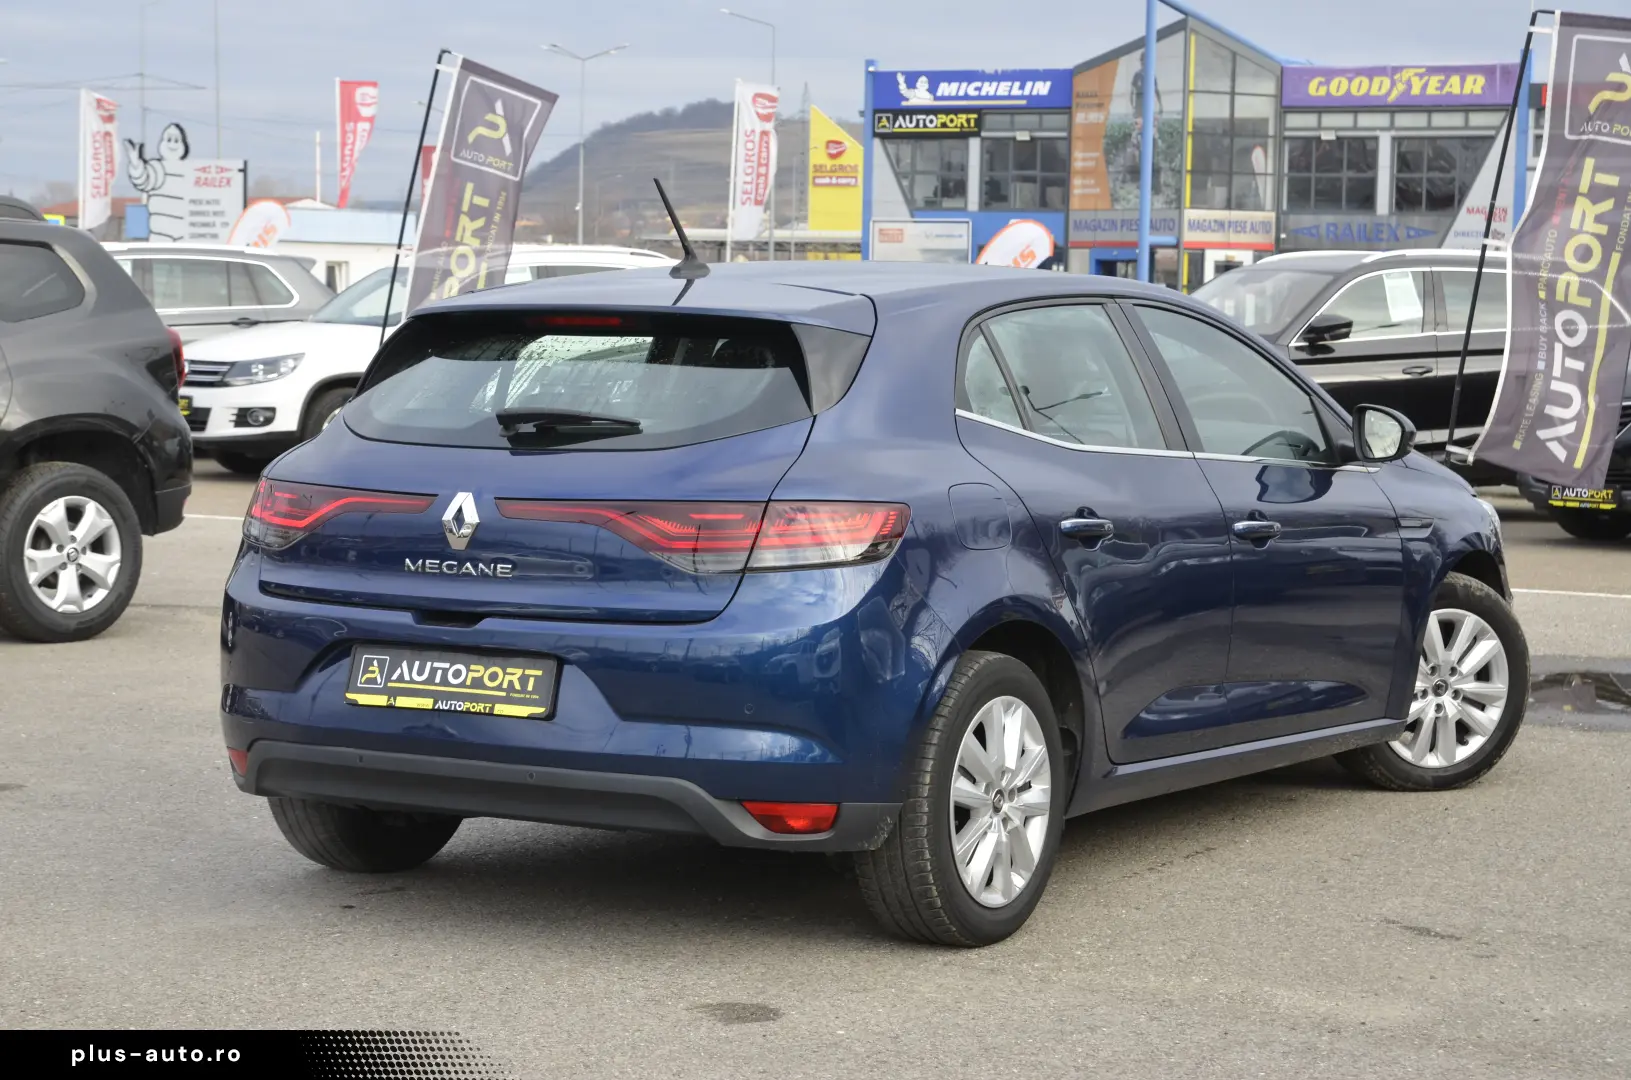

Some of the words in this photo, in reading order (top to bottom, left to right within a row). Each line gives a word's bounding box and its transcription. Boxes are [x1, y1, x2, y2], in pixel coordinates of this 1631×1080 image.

[936, 81, 1051, 96] MICHELIN
[1308, 74, 1486, 97] GOODYEAR
[894, 114, 978, 128] AUTOPORT
[1580, 121, 1610, 133] AUTO
[1612, 123, 1631, 136] PO
[485, 155, 514, 172] PORT
[741, 129, 756, 206] SELGROS
[1073, 219, 1118, 232] MAGAZIN
[1120, 218, 1140, 231] PIES
[1150, 218, 1175, 231] AUTO
[1187, 220, 1225, 232] MAGAZIN
[1227, 220, 1247, 233] PIESE
[1249, 220, 1272, 233] AUTO
[1325, 222, 1401, 243] RAILEX
[1536, 157, 1619, 463] AUTOPORT
[1524, 373, 1544, 418] LEASING
[1537, 338, 1548, 360] BUY
[1563, 488, 1613, 499] AUTOPORT
[404, 558, 513, 578] MEGANE
[391, 660, 542, 691] AUTOPORT
[434, 700, 492, 713] AUTOPORT
